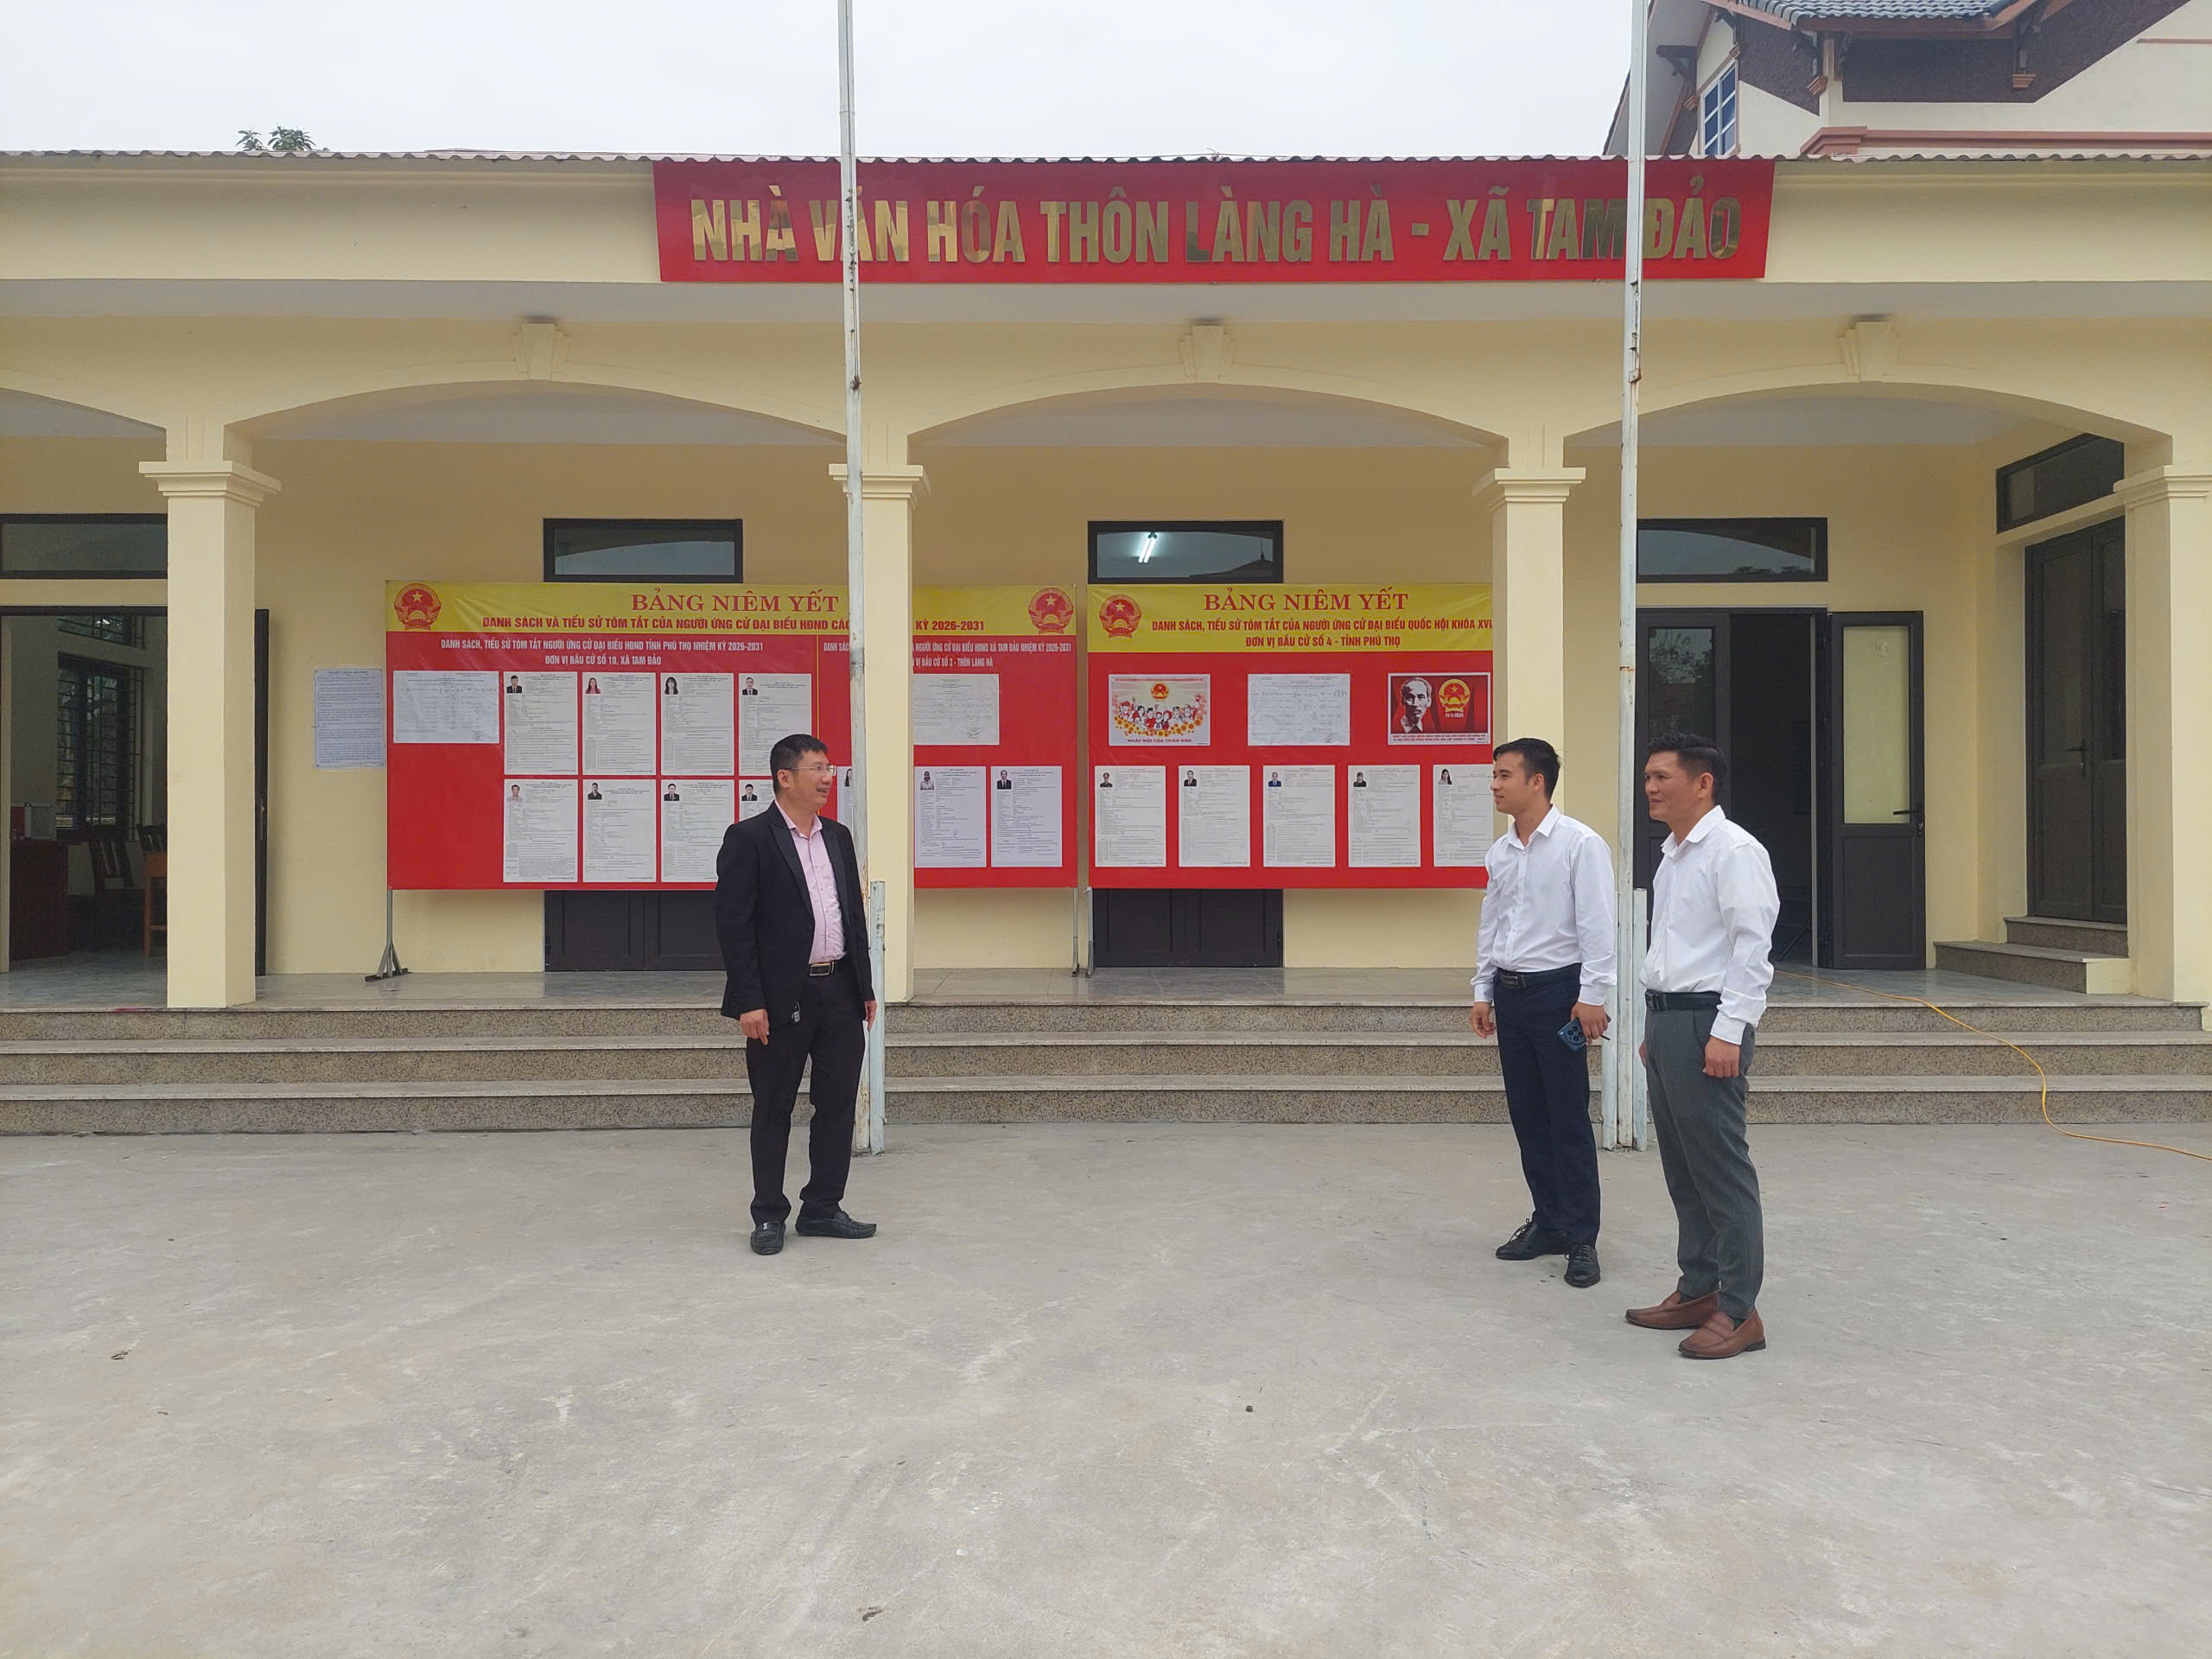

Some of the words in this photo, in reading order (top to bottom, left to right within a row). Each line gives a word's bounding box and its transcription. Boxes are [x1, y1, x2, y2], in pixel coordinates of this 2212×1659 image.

[691, 185, 798, 262] NHÀ
[926, 185, 1026, 263] HÓA
[1039, 186, 1169, 264] THÔN
[1185, 186, 1313, 263] LÀNG
[1329, 185, 1395, 262] HÀ
[1410, 222, 1430, 236] -
[1443, 185, 1512, 262] XÃ
[1527, 198, 1628, 260] TAM
[1643, 175, 1741, 259] ĐẢO
[631, 588, 705, 611] BẢNG
[712, 589, 782, 612] NIÊM
[787, 589, 839, 612] YẾT
[1203, 588, 1276, 611] BẢNG
[1283, 589, 1351, 610] NIÊM
[1358, 587, 1408, 610] YẾT
[482, 617, 512, 628] DANH
[515, 614, 543, 628] SÁCH
[546, 614, 560, 628] VÀ
[563, 614, 585, 628] TIỂU
[588, 614, 602, 628] SỬ
[606, 616, 628, 628] TÓM
[631, 614, 649, 629] TẮT
[652, 615, 673, 629] CỦA
[676, 617, 709, 629] NGƯỜI
[711, 617, 733, 629] ỨNG
[735, 616, 751, 630] CỬ
[753, 620, 771, 632] ĐẠI
[773, 616, 797, 630] BIỂU
[915, 619, 929, 631] KỲ
[932, 620, 985, 631] 2026-2031
[1152, 621, 1176, 631] DANH
[1179, 619, 1205, 632] SÁCH,
[1208, 617, 1226, 631] TIỂU
[1229, 618, 1241, 631] SỬ
[1243, 619, 1262, 631] TÓM
[1265, 618, 1281, 631] TẮT
[1282, 618, 1300, 631] CỦA
[1302, 618, 1330, 631] NGƯỜI
[1332, 618, 1351, 630] ỨNG
[1353, 617, 1366, 630] CỬ
[1368, 620, 1382, 632] ĐẠI
[1385, 616, 1406, 630] BIỂU
[1408, 617, 1432, 631] QUỐC
[1434, 618, 1449, 632] HỘI
[1452, 618, 1476, 630] KHÓA
[441, 639, 461, 649] DANH
[462, 637, 483, 651] SÁCH,
[484, 637, 499, 649] TIỂU
[512, 637, 528, 650] TÓM
[543, 639, 565, 650] NGƯỜI
[567, 639, 581, 650] ỨNG
[607, 637, 623, 651] BIỂU
[645, 638, 662, 651] TỈNH
[663, 639, 677, 651] PHÚ
[678, 641, 692, 652] THỌ
[693, 641, 716, 652] NHIỆM
[728, 642, 763, 652] 2026-2031
[839, 641, 849, 652] SÁC
[1245, 636, 1264, 647] ĐƠN
[1267, 637, 1275, 649] VỊ
[1277, 634, 1295, 647] BẦU
[1298, 633, 1311, 647] CỬ
[1312, 634, 1325, 647] SỐ
[1326, 636, 1332, 646] 4
[1340, 633, 1361, 646] TỈNH
[1363, 634, 1382, 646] PHÚ
[1384, 636, 1401, 648] THỌ
[545, 654, 560, 664] ĐƠN
[562, 656, 569, 667] VỊ
[596, 654, 607, 664] SỐ
[620, 654, 630, 665] XÃ
[632, 657, 646, 665] TAM
[647, 654, 662, 665] ĐẢO
